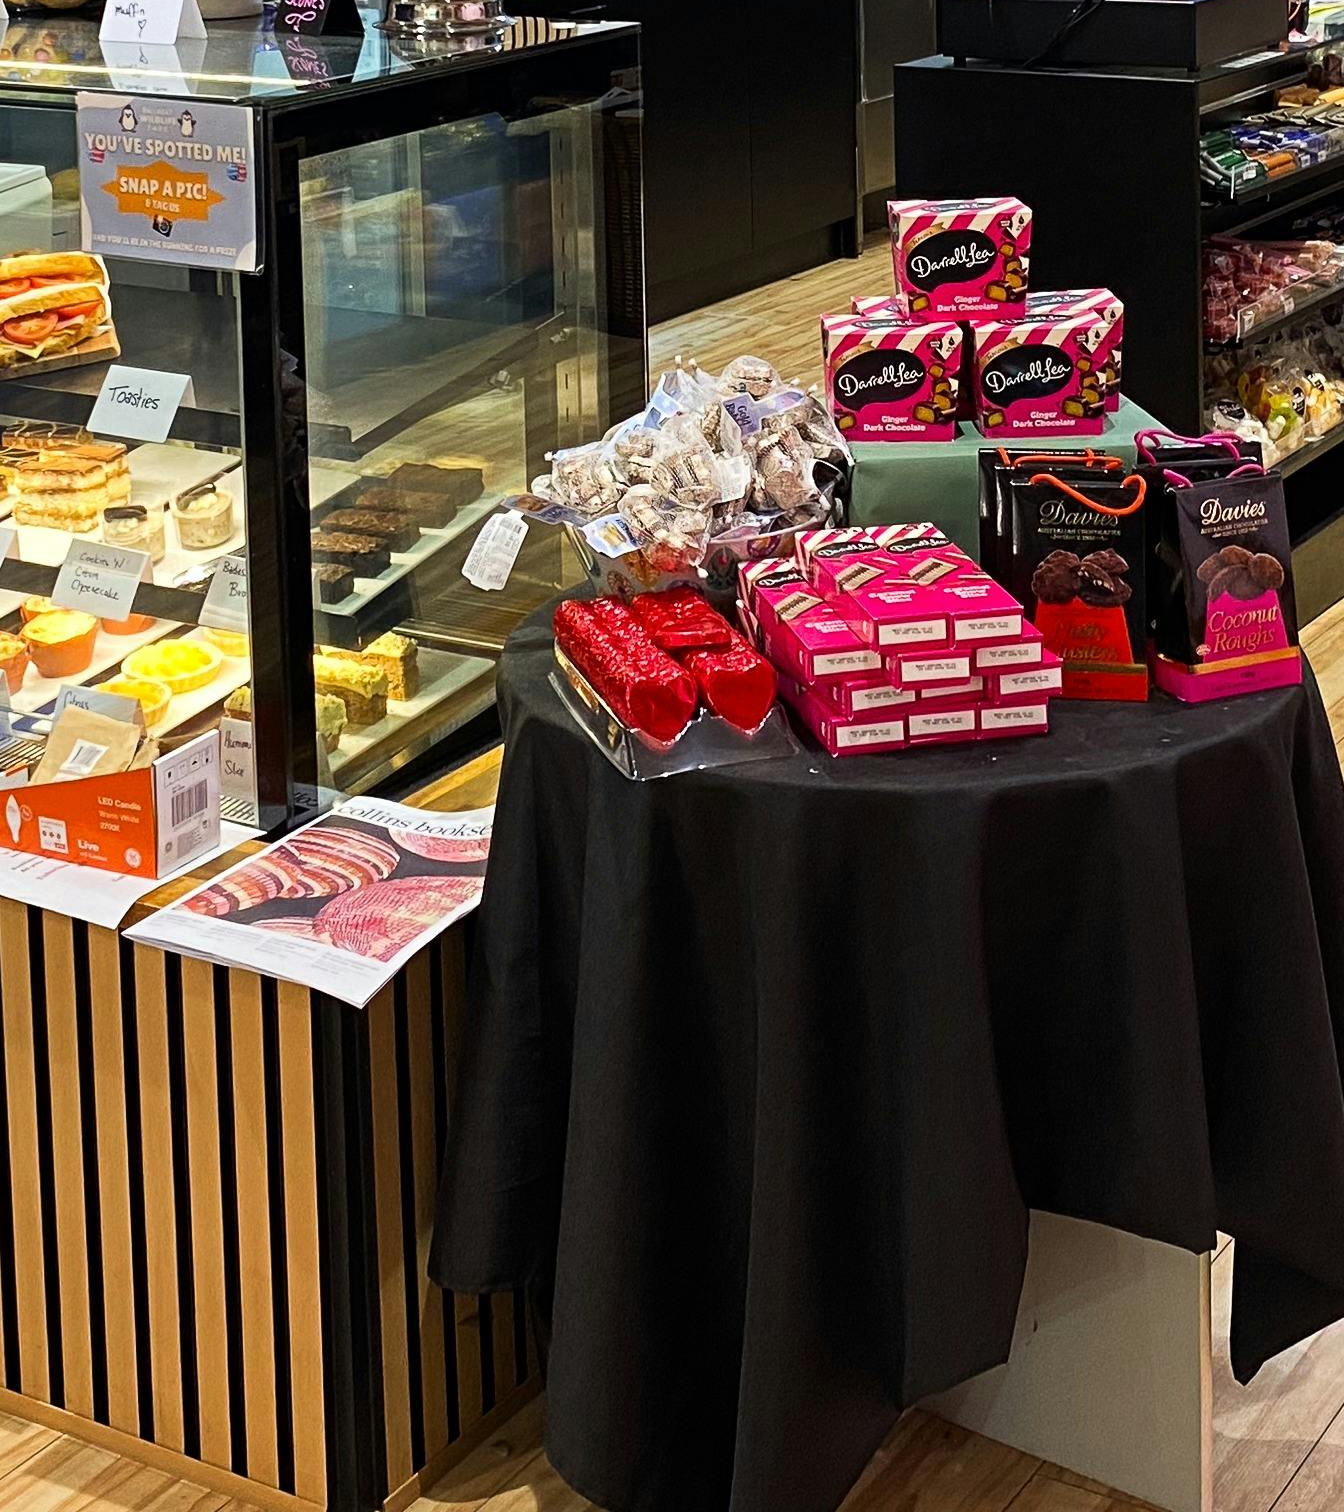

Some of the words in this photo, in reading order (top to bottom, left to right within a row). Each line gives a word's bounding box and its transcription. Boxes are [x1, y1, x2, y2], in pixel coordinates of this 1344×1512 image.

[84, 132, 143, 154] YOU'VE
[146, 139, 213, 163] SPOTTED
[217, 146, 247, 164] ME!
[119, 176, 158, 196] SNAP
[163, 181, 174, 197] A
[176, 183, 208, 200] PIC!
[911, 245, 970, 278] Darrell
[966, 243, 996, 268] Lea
[954, 296, 981, 304] Ginger
[958, 303, 998, 311] Chocolate
[838, 365, 896, 397] Darrell
[894, 362, 924, 388] Lea
[108, 385, 161, 411] Toasties
[1200, 498, 1266, 525] Davies
[1209, 604, 1278, 633] Coconut
[1213, 625, 1276, 654] Roughs
[97, 796, 114, 807] LED
[114, 799, 142, 812] Candle
[337, 804, 410, 828] collins
